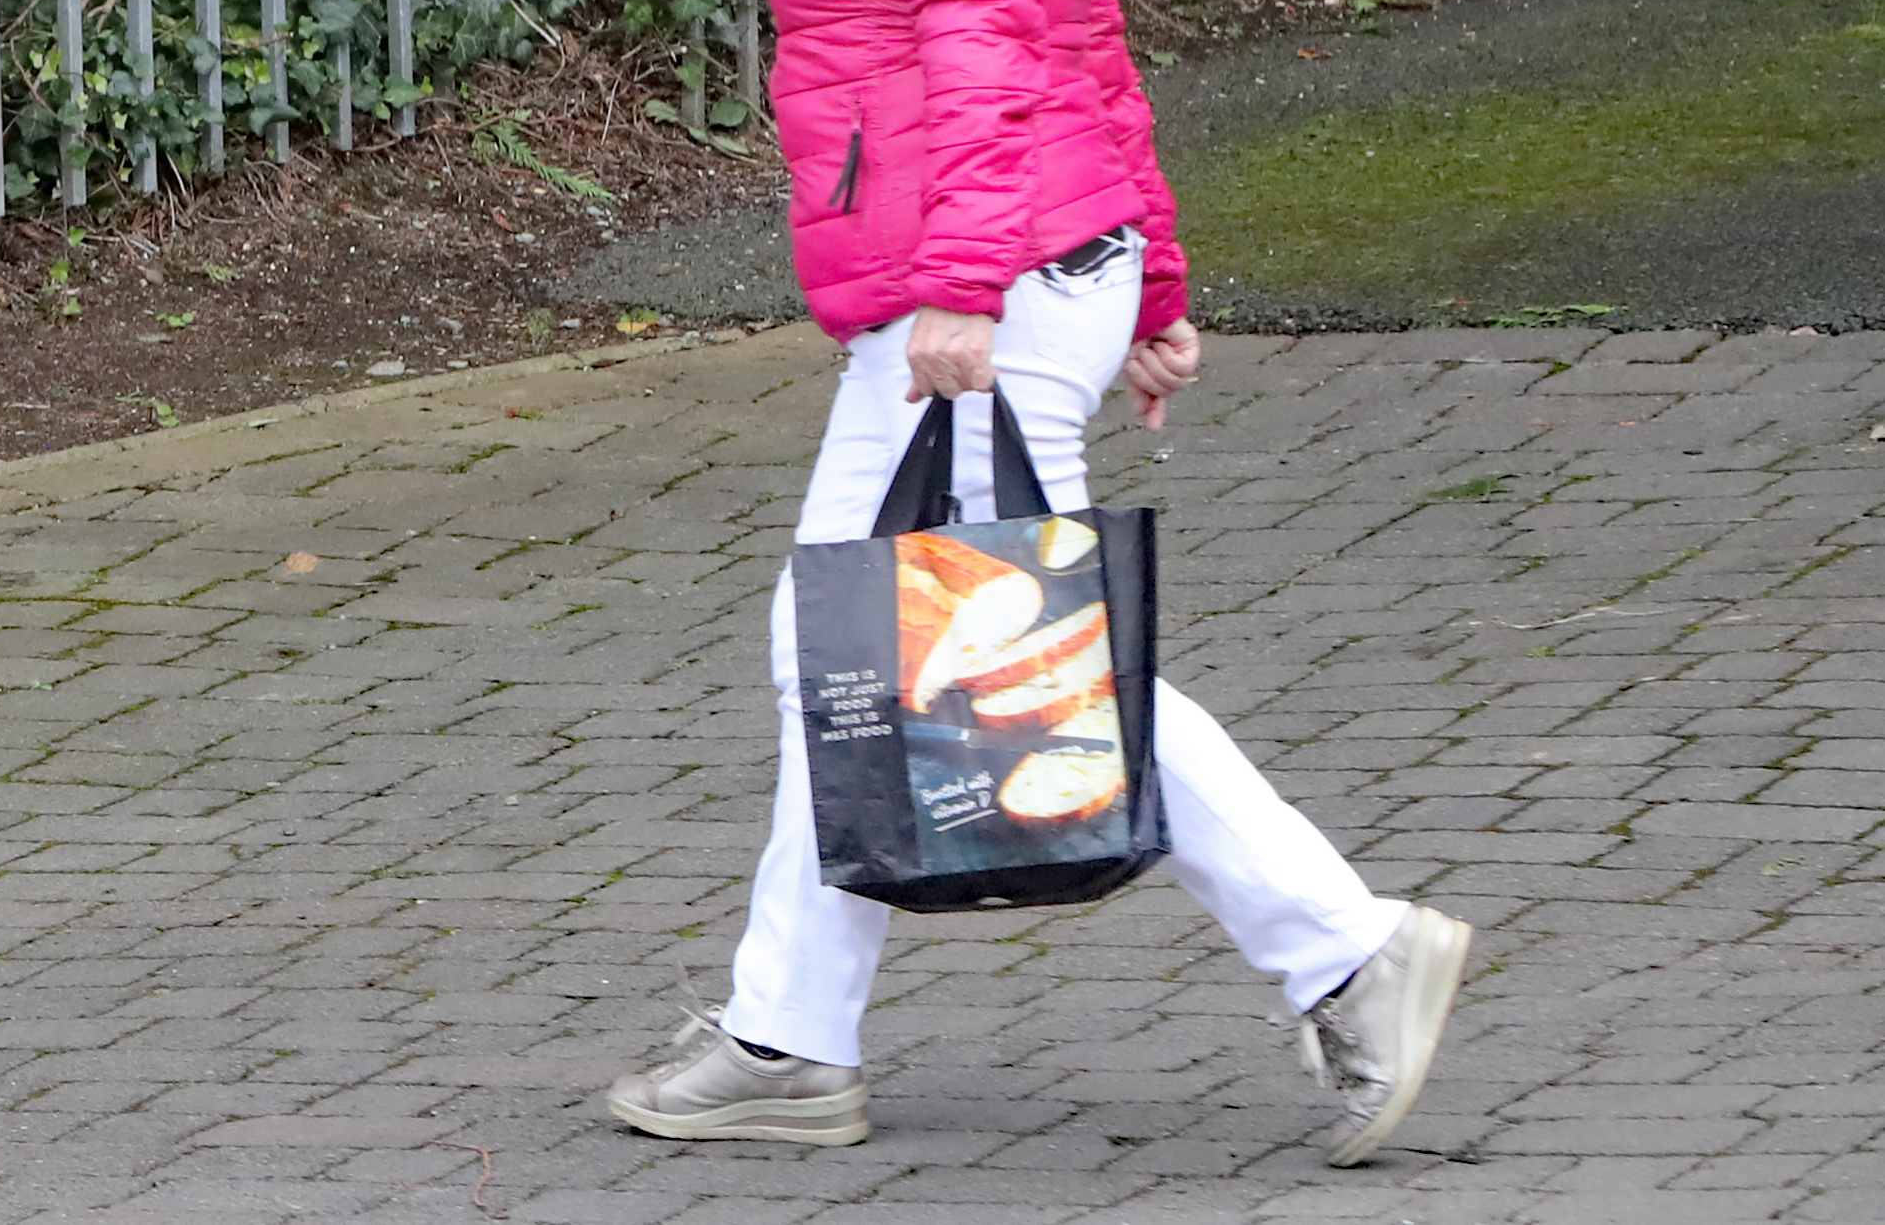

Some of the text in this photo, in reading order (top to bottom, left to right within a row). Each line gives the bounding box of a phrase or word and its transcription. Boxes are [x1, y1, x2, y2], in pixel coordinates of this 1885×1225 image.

[825, 669, 877, 683] THIS IS
[818, 682, 886, 699] NOT JUST
[832, 697, 873, 711] FOOD
[828, 711, 880, 727] THIS IS
[851, 724, 893, 738] FOOD
